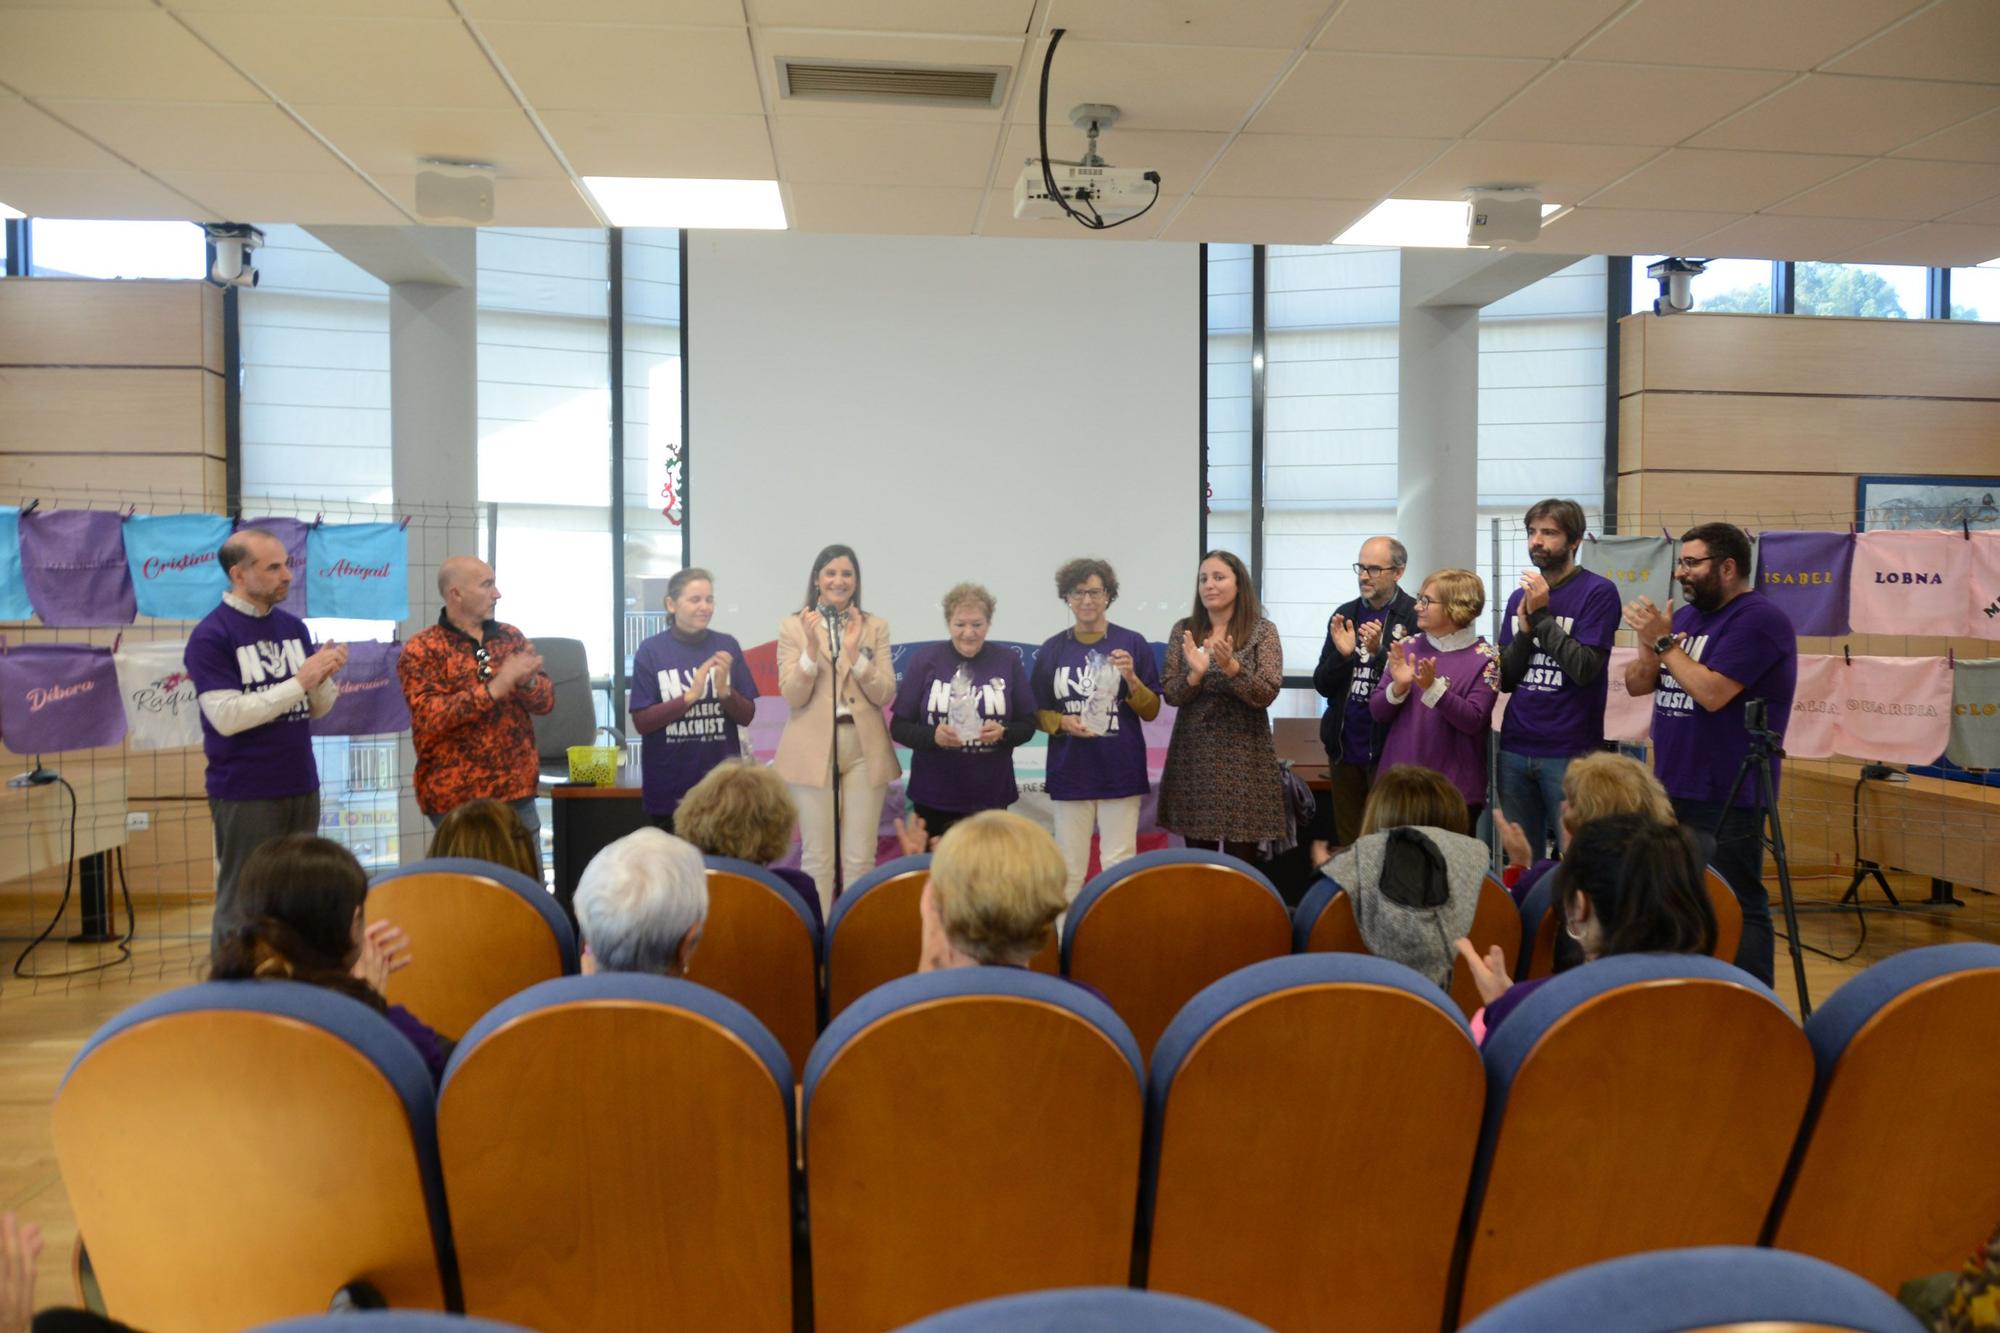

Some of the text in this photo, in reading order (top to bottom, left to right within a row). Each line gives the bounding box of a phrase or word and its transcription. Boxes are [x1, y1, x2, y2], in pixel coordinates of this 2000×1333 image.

[1764, 571, 1833, 585] ISABEL
[1875, 571, 1943, 585] LOBNA
[1983, 595, 2000, 619] M
[1954, 703, 2000, 716] CLO
